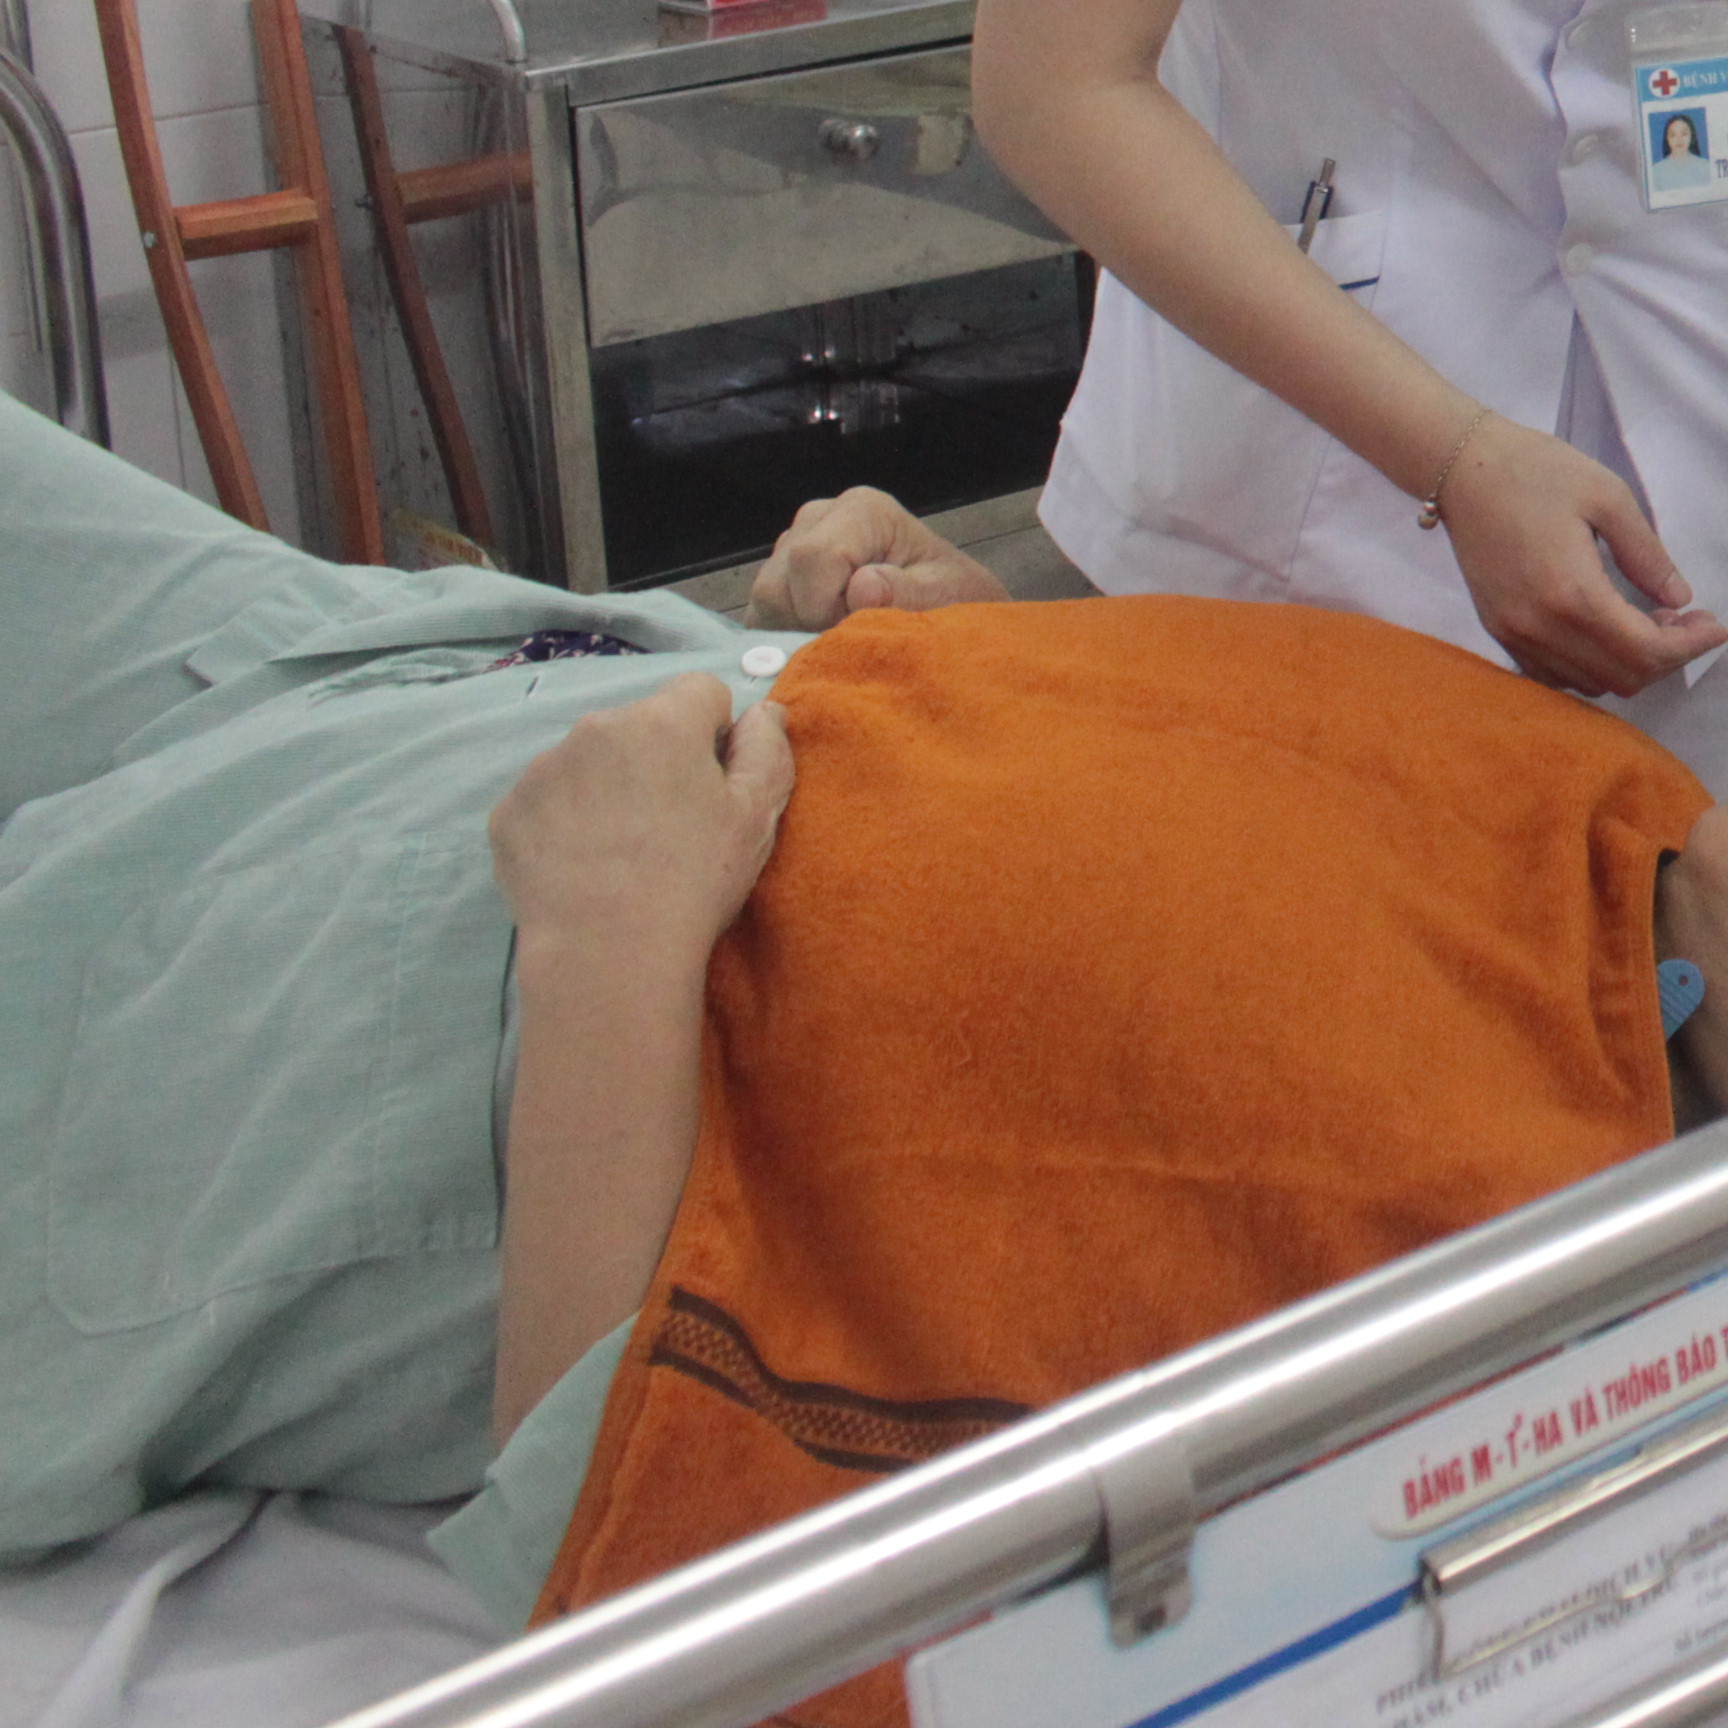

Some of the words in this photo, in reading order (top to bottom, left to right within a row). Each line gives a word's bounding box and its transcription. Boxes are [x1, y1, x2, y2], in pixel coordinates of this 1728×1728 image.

[1401, 1456, 1466, 1520] BẢNG
[1570, 1387, 1599, 1436] VÀ
[1602, 1361, 1672, 1419] THÔNG
[1675, 1331, 1717, 1382] BÁO
